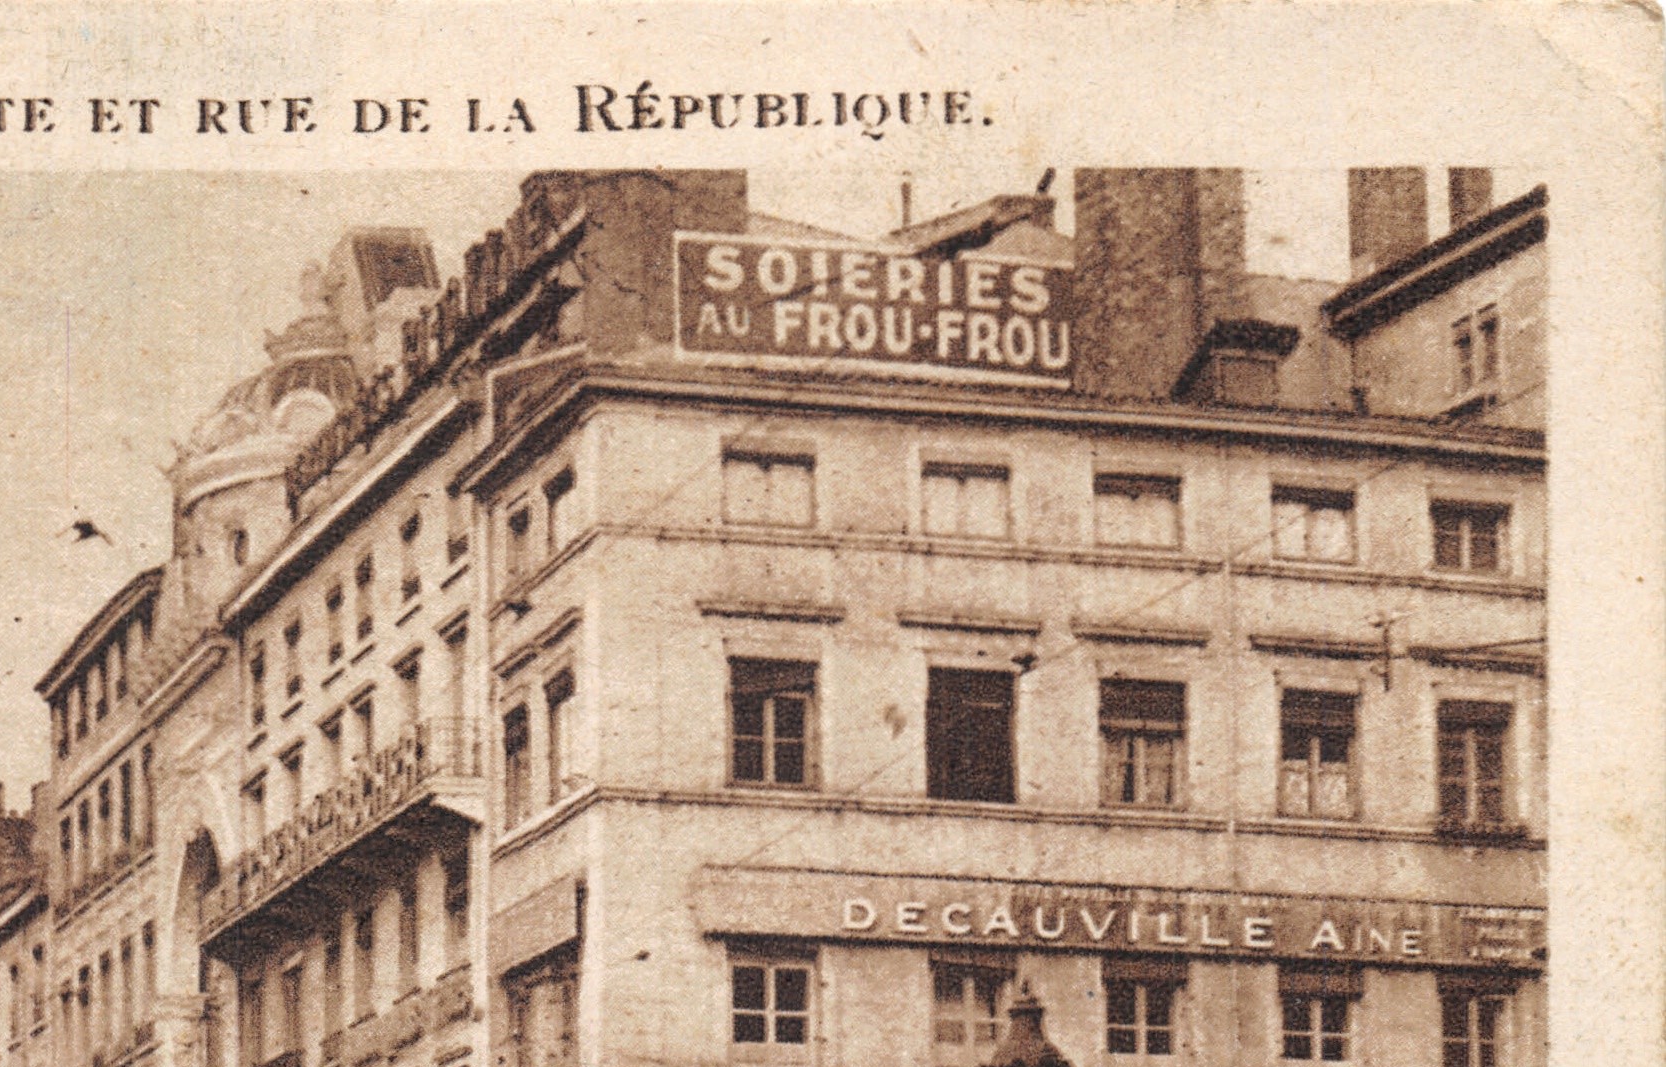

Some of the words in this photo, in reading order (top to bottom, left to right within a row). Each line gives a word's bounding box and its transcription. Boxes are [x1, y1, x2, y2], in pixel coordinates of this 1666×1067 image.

[703, 245, 1051, 313] SOIERIES
[696, 302, 750, 336] AU
[841, 896, 1275, 948] DECAUVILLE
